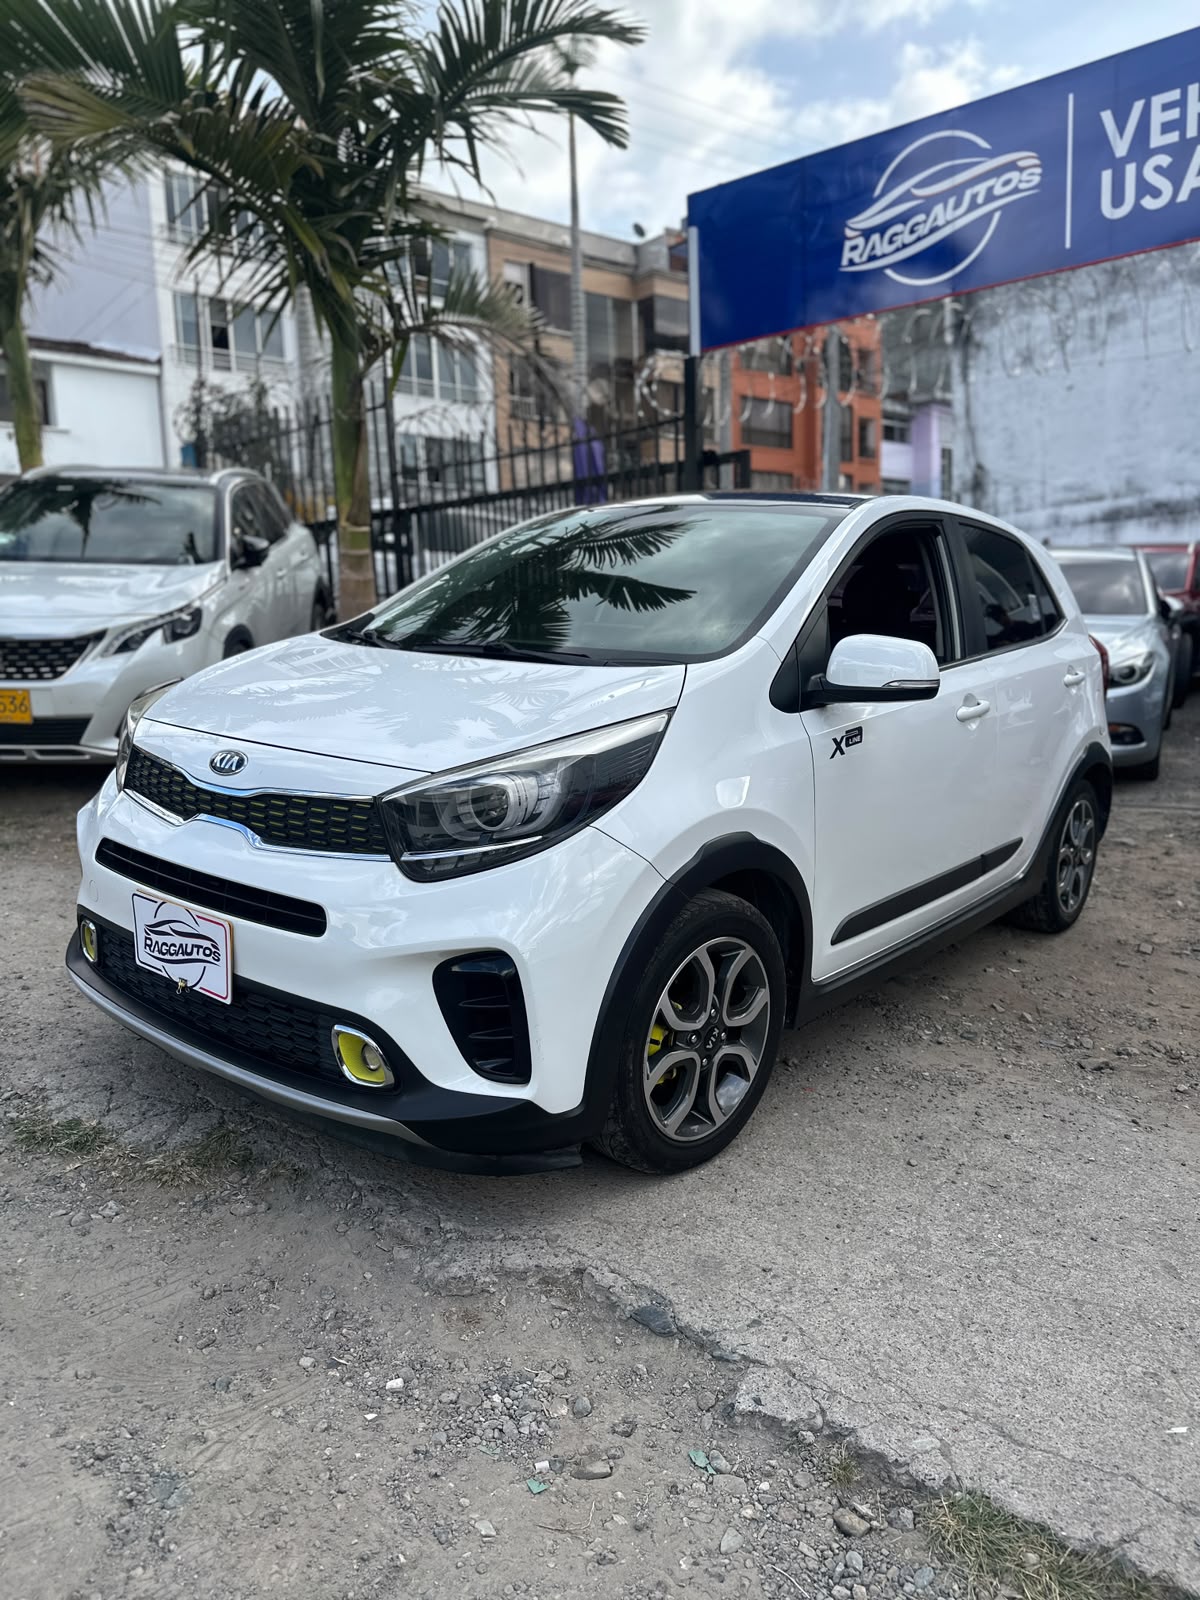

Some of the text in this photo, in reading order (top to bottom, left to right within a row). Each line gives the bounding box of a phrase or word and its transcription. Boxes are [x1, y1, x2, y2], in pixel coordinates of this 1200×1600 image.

[841, 166, 1043, 266] RAGGAUTOS
[212, 752, 240, 771] KIA
[144, 935, 221, 963] RAGGAUTOS
[705, 1027, 720, 1049] KIA
